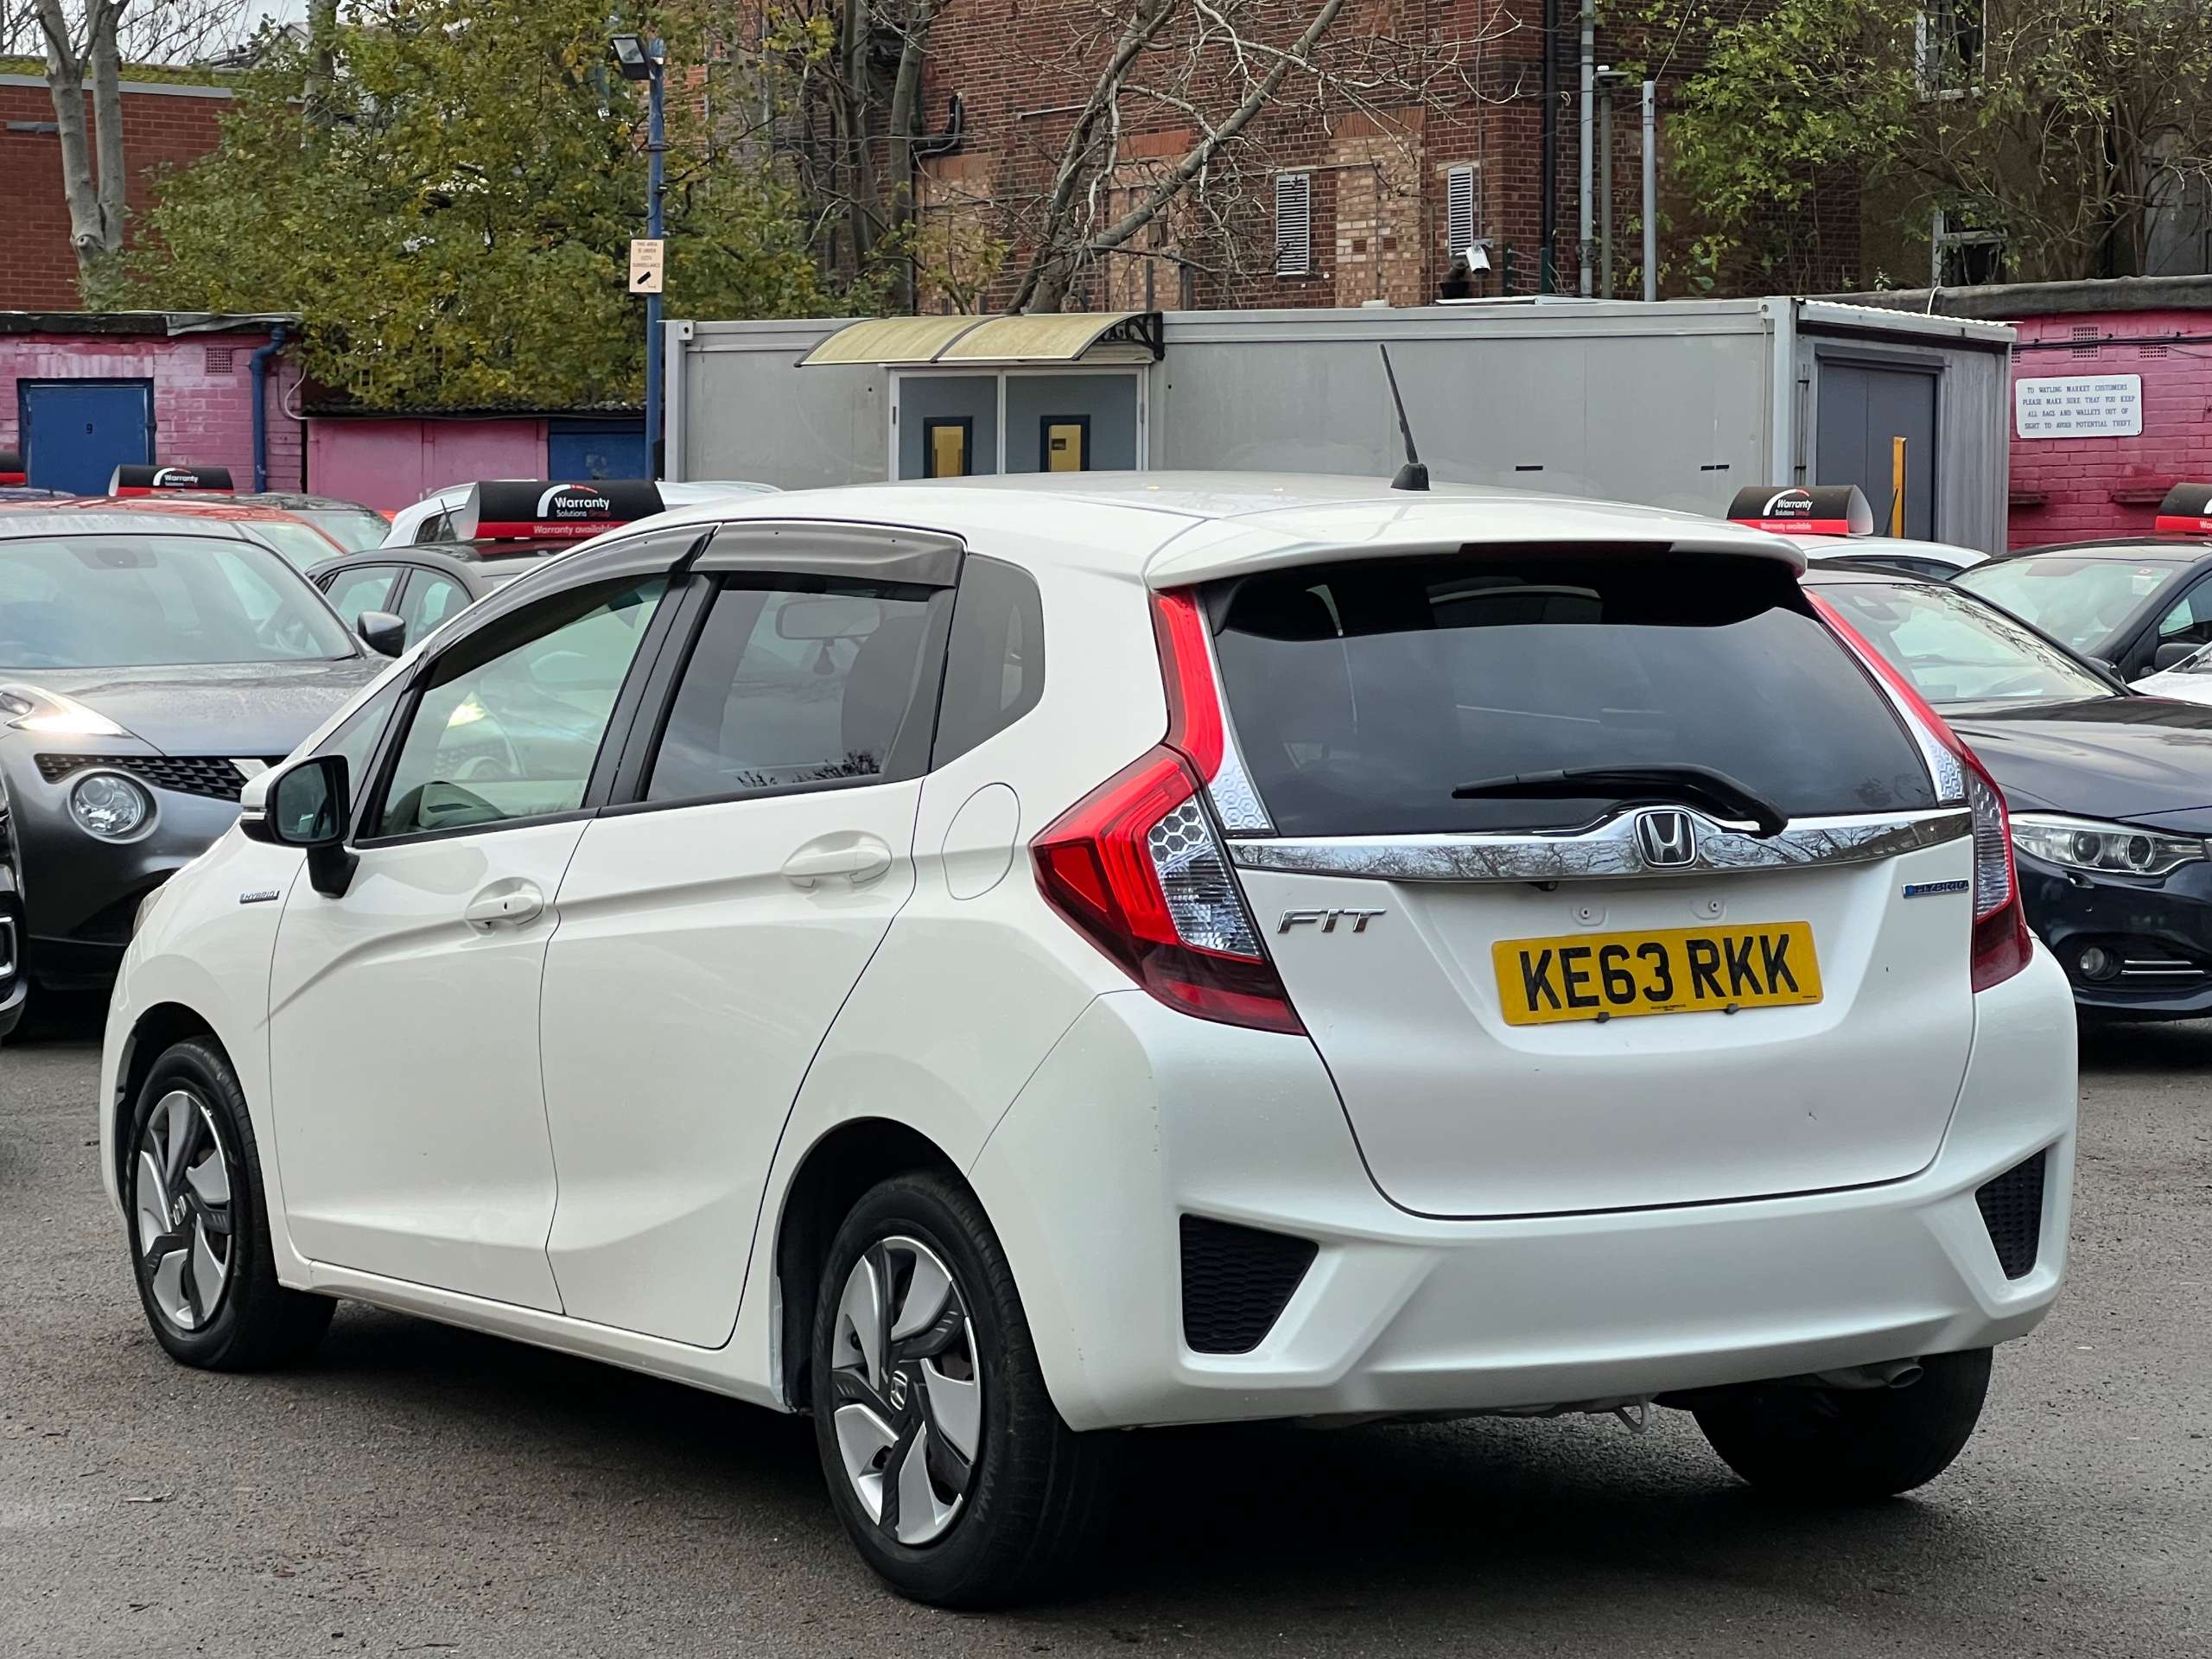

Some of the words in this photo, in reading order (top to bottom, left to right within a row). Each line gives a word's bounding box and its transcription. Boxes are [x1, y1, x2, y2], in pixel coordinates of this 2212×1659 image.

[86, 423, 92, 435] 9
[164, 474, 199, 484] Warranty
[555, 497, 610, 511] Warranty
[1777, 499, 1814, 512] Warranty
[533, 525, 573, 536] Warranty
[1760, 522, 1785, 531] Warranty
[1914, 881, 1968, 895] HYBRID
[242, 891, 279, 900] HYBRID
[1277, 908, 1387, 934] FIT
[1519, 942, 1674, 1012] KE63
[1685, 933, 1799, 999] RKK
